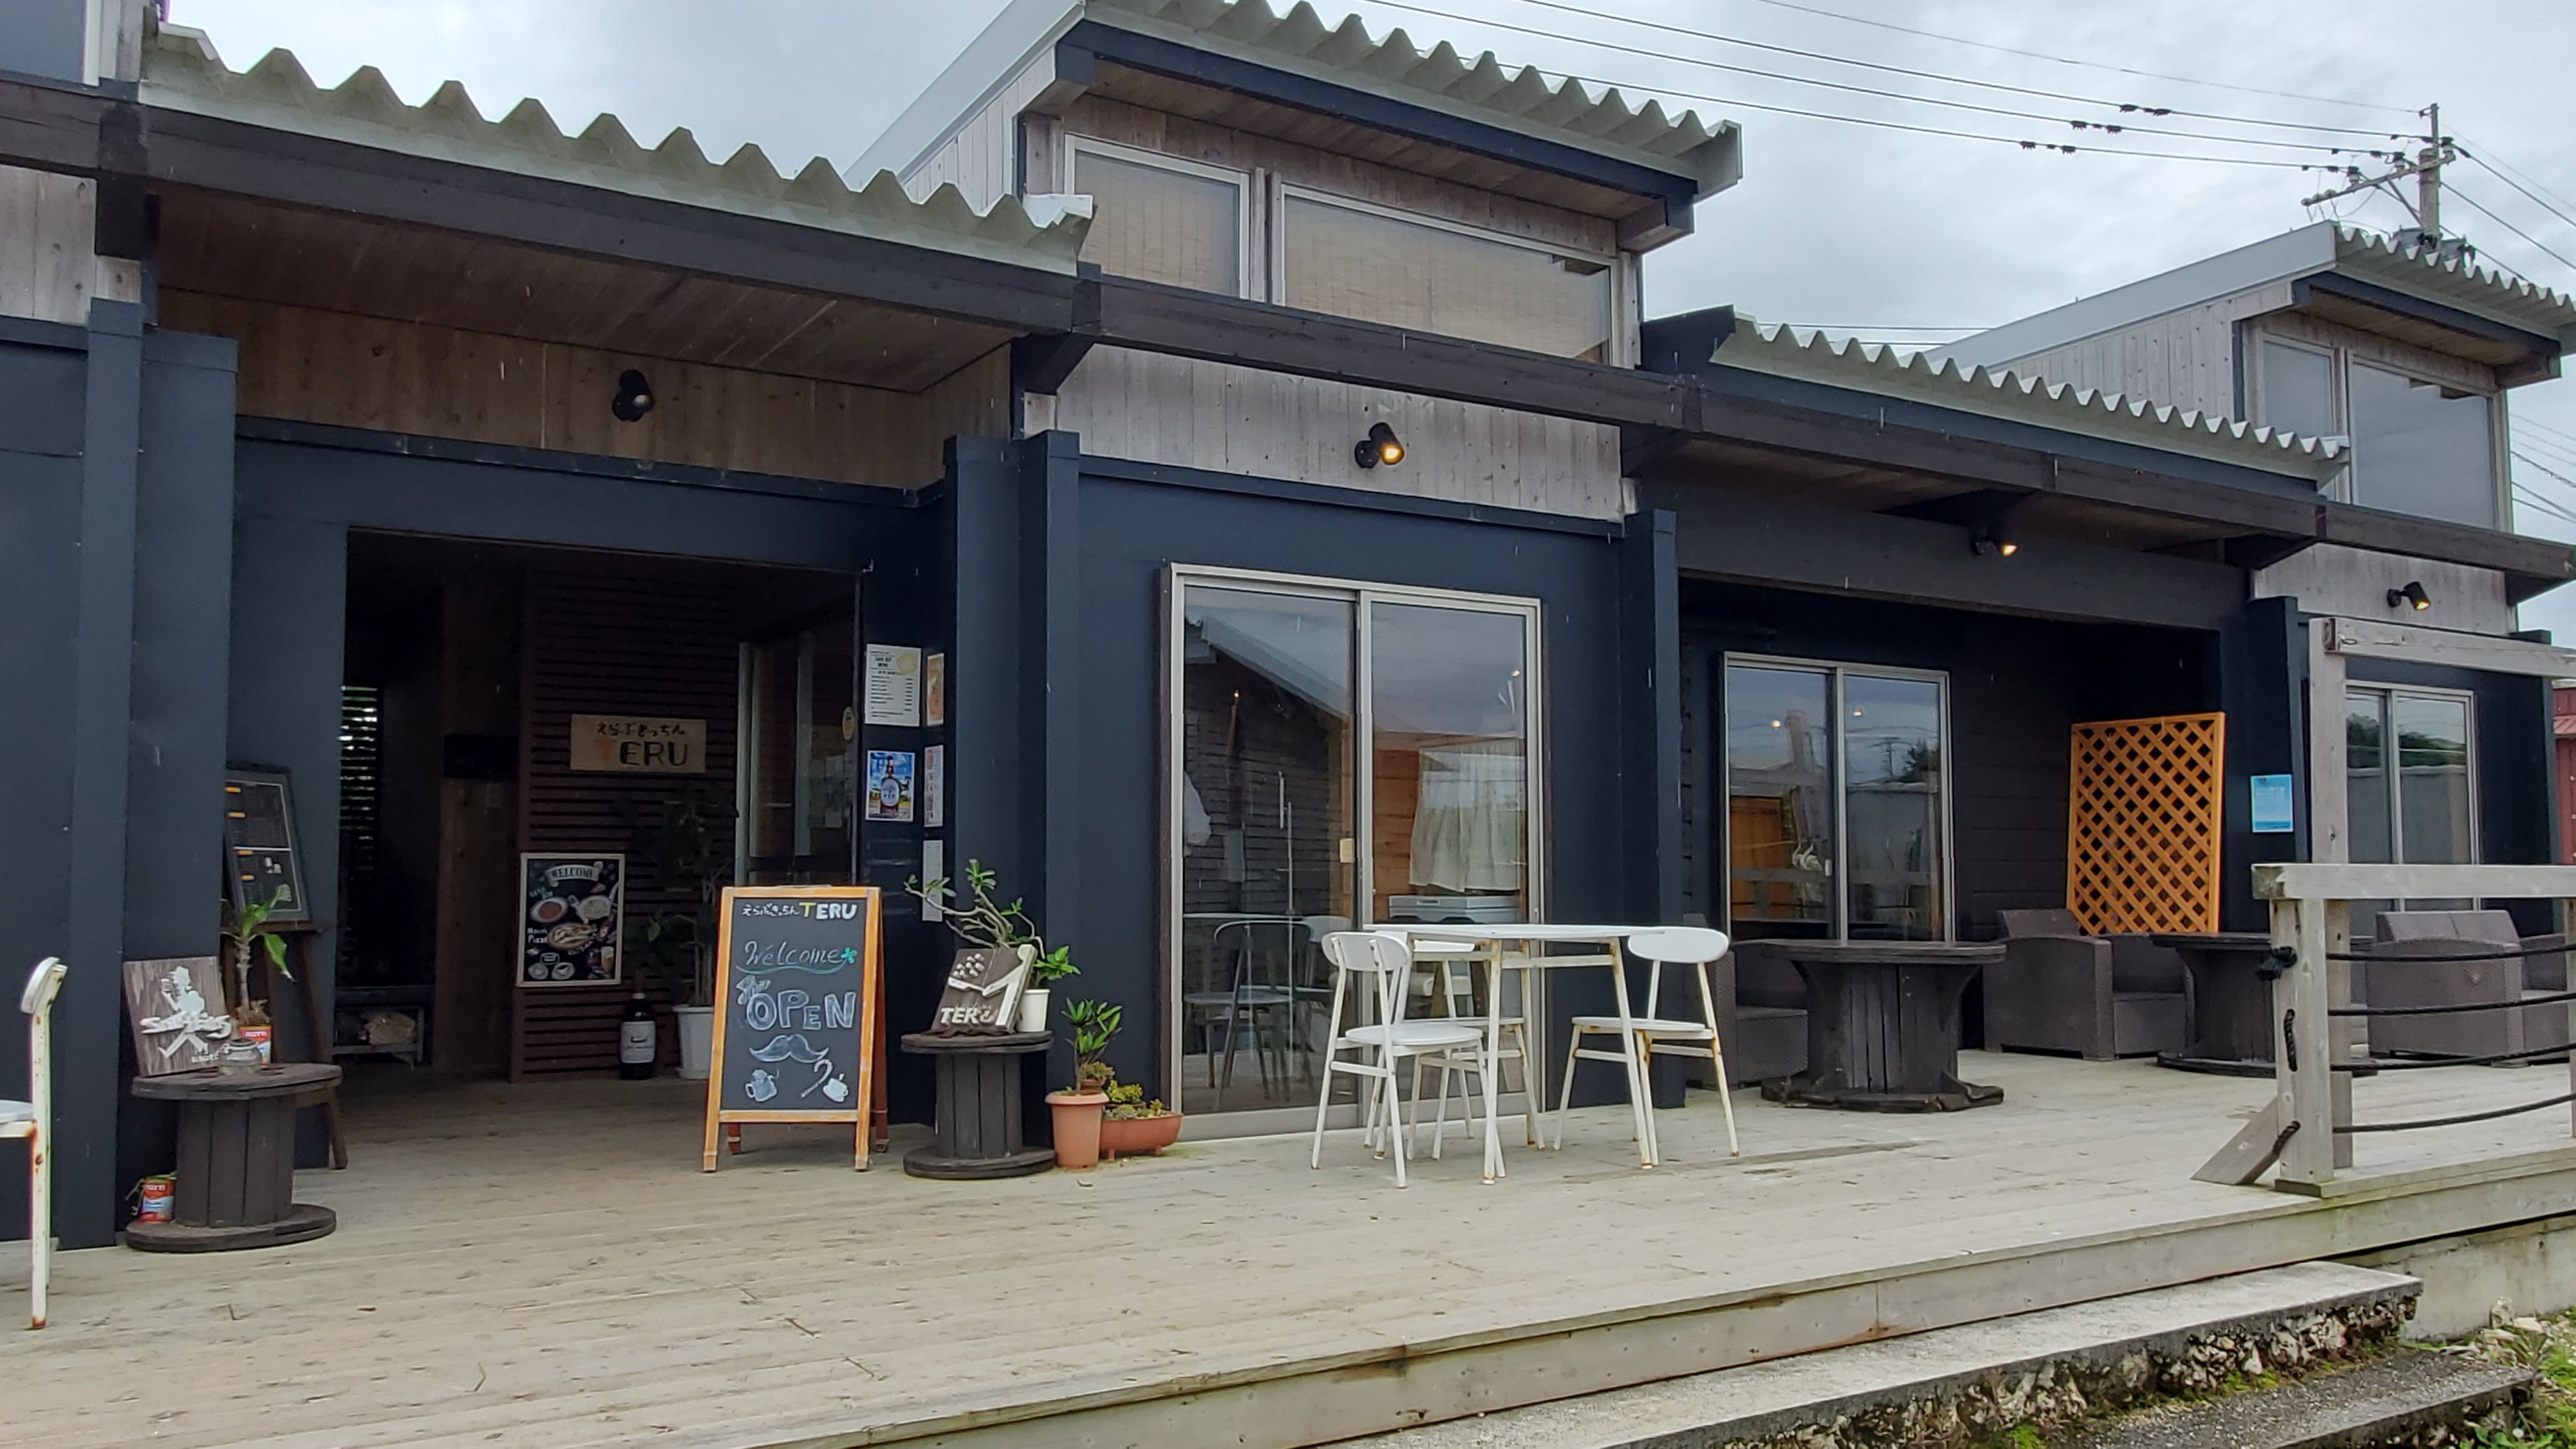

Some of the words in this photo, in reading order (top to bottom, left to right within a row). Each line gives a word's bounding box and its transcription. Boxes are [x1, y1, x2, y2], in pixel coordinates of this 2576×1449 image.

[596, 721, 686, 738] えらぶきっちん
[594, 738, 688, 767] TERU
[742, 902, 800, 917] えらぶきっちん
[799, 901, 858, 919] TERU
[744, 940, 843, 966] Welcome
[746, 989, 857, 1031] OPEN
